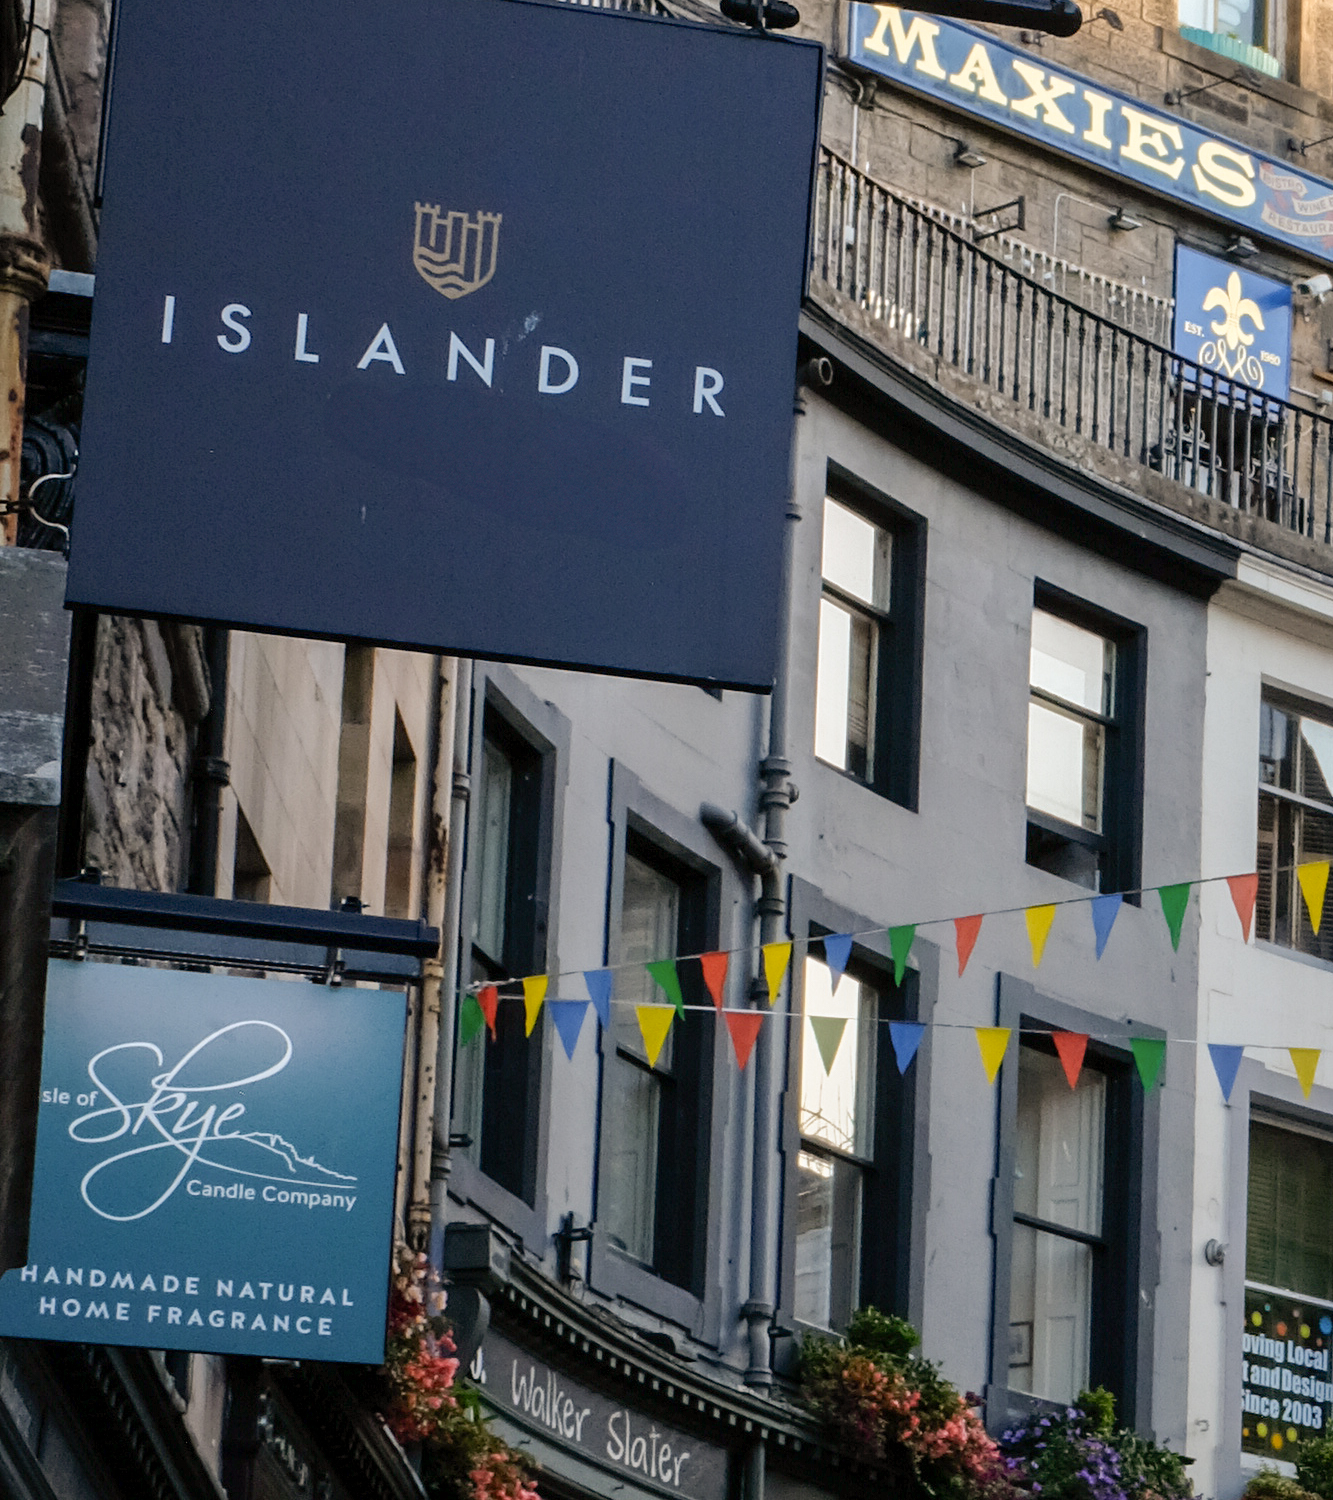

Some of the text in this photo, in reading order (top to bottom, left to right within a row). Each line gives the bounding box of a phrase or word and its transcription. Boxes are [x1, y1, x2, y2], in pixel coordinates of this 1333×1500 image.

[863, 4, 1257, 208] MAXIES
[1263, 172, 1303, 191] BISTRO
[1298, 201, 1326, 213] WINE
[159, 292, 728, 418] ISLANDER
[42, 1019, 294, 1222] sle of Skye
[186, 1179, 358, 1213] Candle Company
[20, 1265, 355, 1308] HANDMADE NATURAL
[39, 1296, 333, 1337] HOME FRAGRANCE
[1242, 1332, 1285, 1363] oving
[1287, 1339, 1329, 1372] Local
[1250, 1363, 1281, 1390] and
[1281, 1367, 1333, 1403] Design
[511, 1359, 591, 1442] Walker
[606, 1408, 691, 1487] Slater
[1281, 1397, 1323, 1430] 2003
